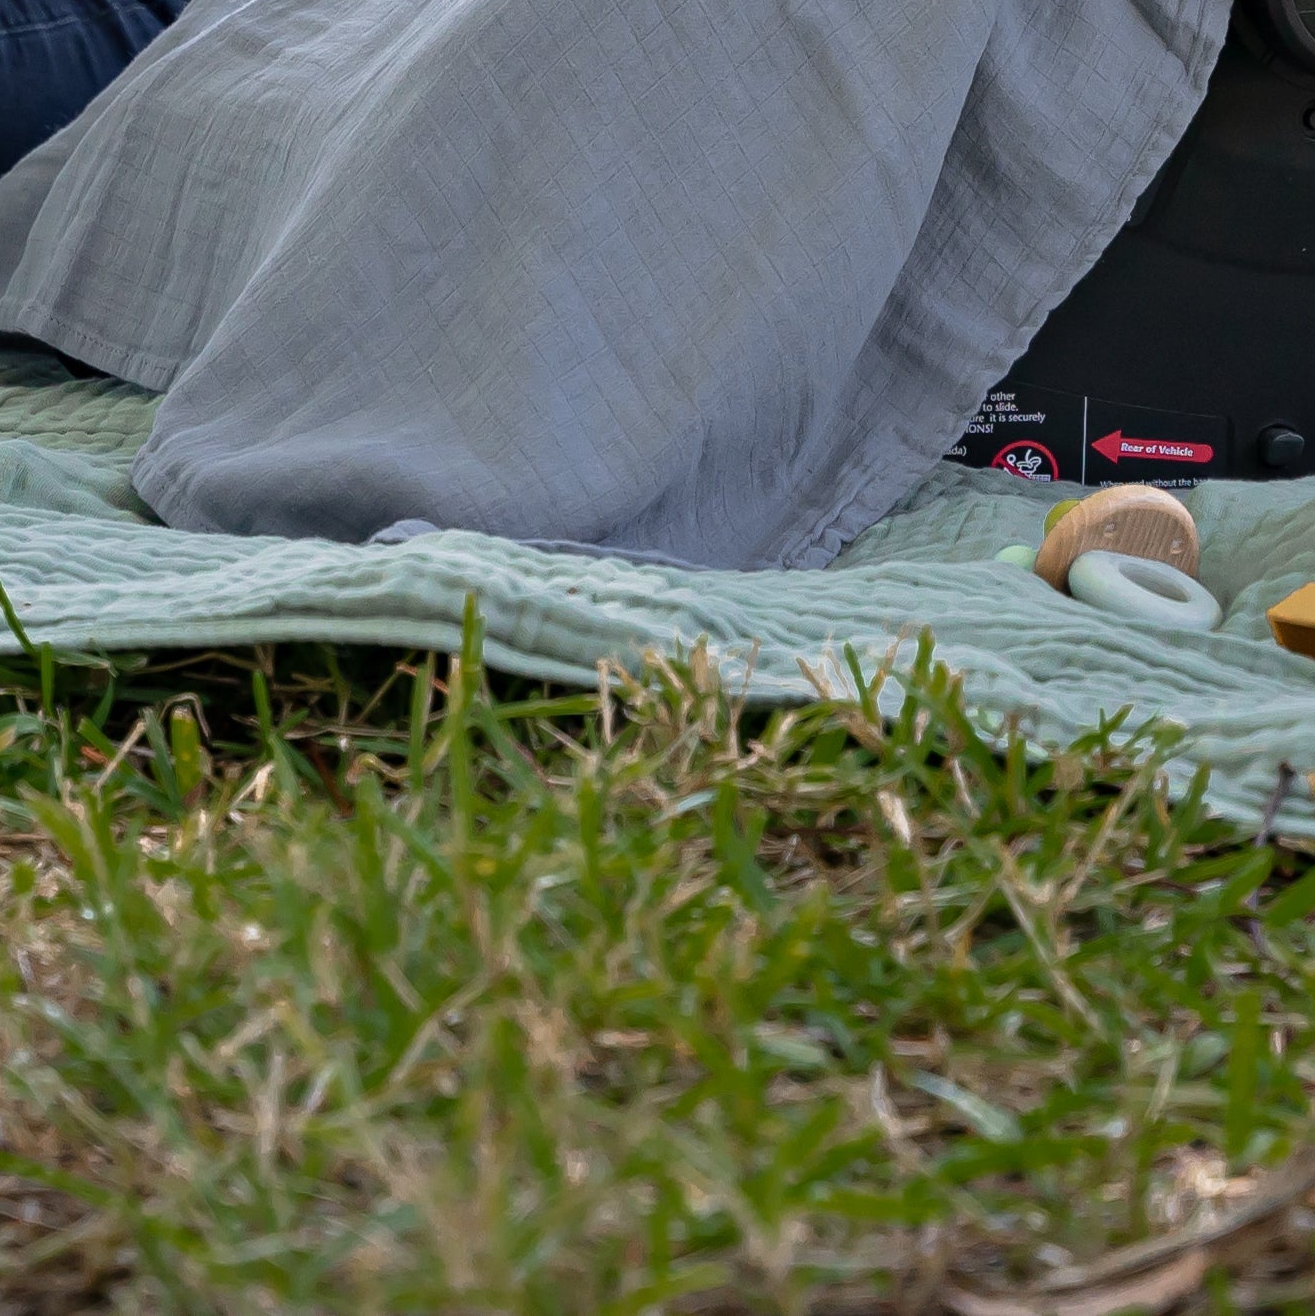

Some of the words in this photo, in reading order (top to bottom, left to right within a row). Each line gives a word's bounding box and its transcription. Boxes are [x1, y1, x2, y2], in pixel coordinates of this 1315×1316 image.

[990, 391, 1015, 402] other
[982, 403, 993, 411] to
[995, 402, 1019, 412] slide.
[970, 414, 985, 423] ure
[989, 413, 996, 422] it
[999, 413, 1006, 422] is
[1008, 412, 1046, 423] securely
[1120, 442, 1144, 452] Rear
[1145, 445, 1157, 454] of
[1158, 445, 1194, 457] Vehicle
[1178, 478, 1191, 486] the
